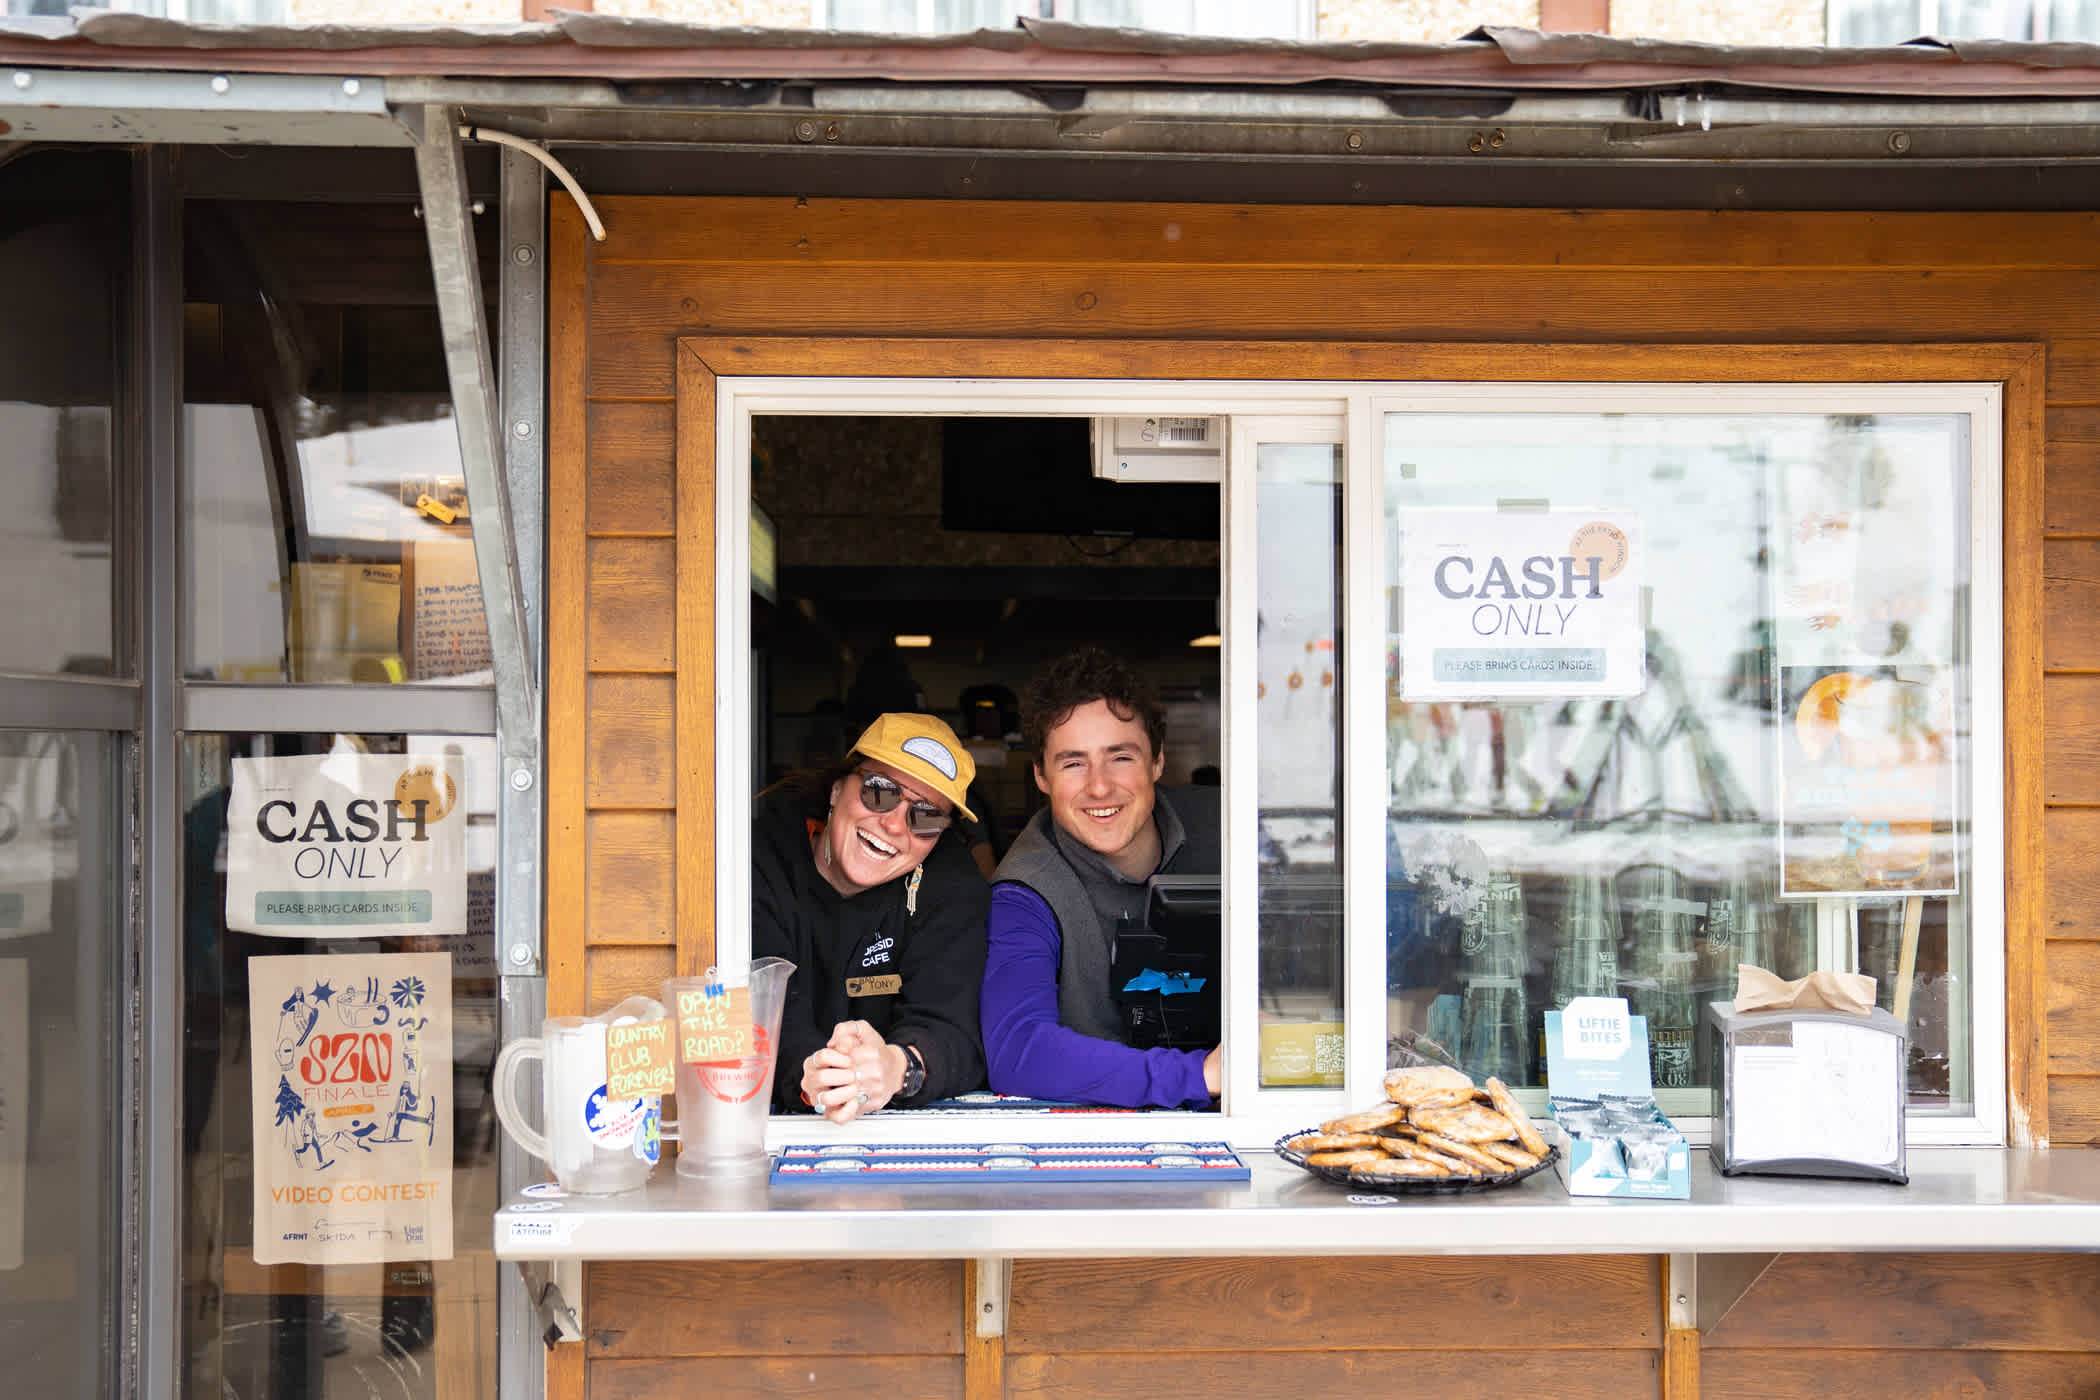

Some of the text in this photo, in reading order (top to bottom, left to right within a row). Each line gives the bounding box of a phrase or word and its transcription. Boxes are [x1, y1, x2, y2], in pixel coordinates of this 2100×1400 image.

[1434, 556, 1604, 600] CASH
[1472, 603, 1578, 636] ONLY
[1444, 659, 1593, 671] PLEASE BRING CARDS INSIDE
[256, 799, 430, 843] CASH
[294, 847, 402, 879] ONLY
[266, 902, 418, 914] PLEASE BRING CARDS INSIDE
[862, 952, 890, 967] CAFE
[680, 991, 731, 1015] OPEN
[682, 1011, 729, 1031] THE
[1578, 1017, 1622, 1030] LIFTIE
[608, 1024, 667, 1048] COUNTRY
[685, 1030, 745, 1058] ROAD?
[1579, 1030, 1623, 1043] BITES
[300, 1033, 392, 1085] SZN
[611, 1046, 651, 1071] CLUB
[303, 1084, 391, 1102] FINALE
[271, 1183, 437, 1205] VIDEO CONTEST
